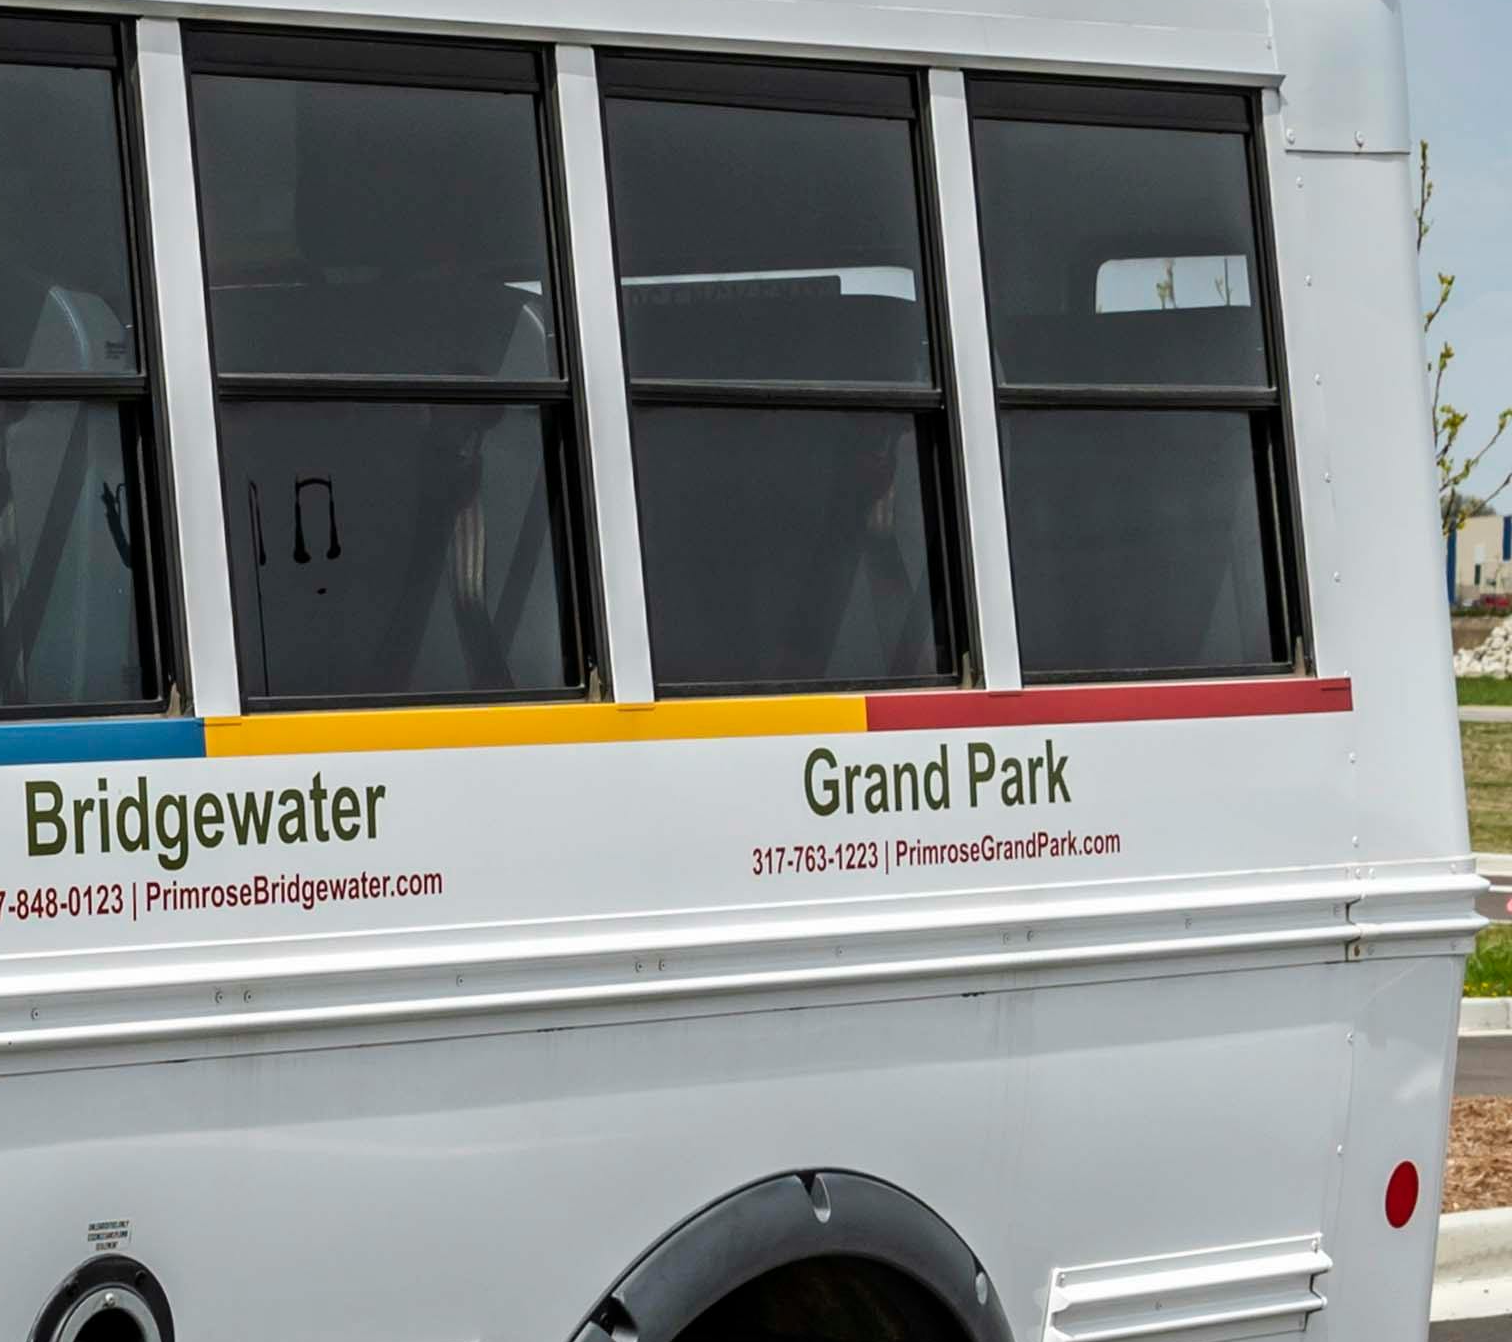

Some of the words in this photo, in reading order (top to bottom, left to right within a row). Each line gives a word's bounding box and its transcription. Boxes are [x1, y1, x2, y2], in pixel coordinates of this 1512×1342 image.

[804, 743, 951, 817] Grand
[967, 739, 1072, 808] Park
[25, 771, 386, 871] Bridgewater
[752, 841, 879, 876] 317-763-1223
[895, 829, 1121, 867] PrimroseGrandPark.com
[146, 871, 443, 912] PrimroseBridgewater.com
